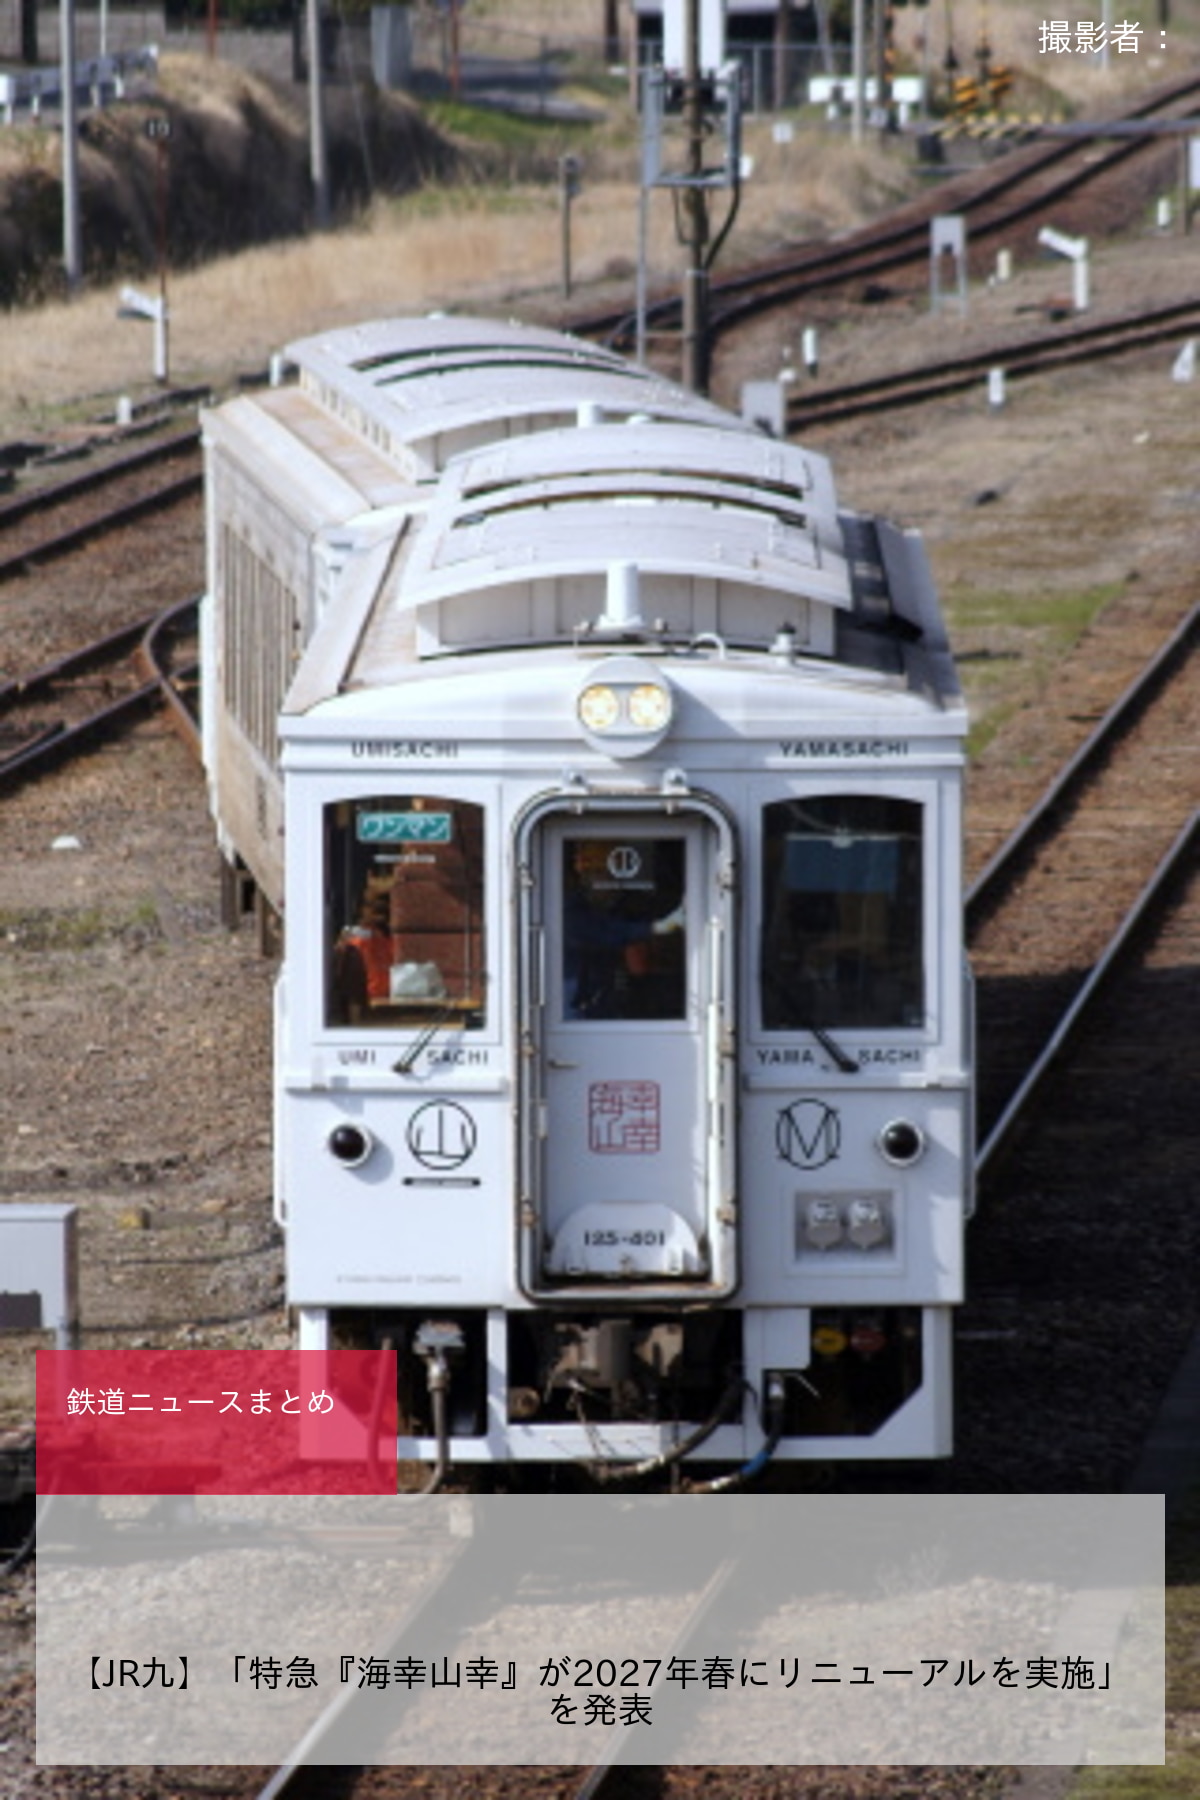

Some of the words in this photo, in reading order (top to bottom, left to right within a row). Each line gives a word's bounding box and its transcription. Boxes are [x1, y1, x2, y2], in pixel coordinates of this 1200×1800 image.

[351, 740, 459, 758] UMISACHI
[779, 740, 908, 758] YAMASACHI
[361, 815, 448, 839] ワンマン
[337, 1049, 376, 1066] UMI
[426, 1049, 489, 1066] SACHI
[756, 1049, 815, 1066] YAMA
[857, 1049, 920, 1065] SACHI
[584, 1230, 665, 1247] 125-401
